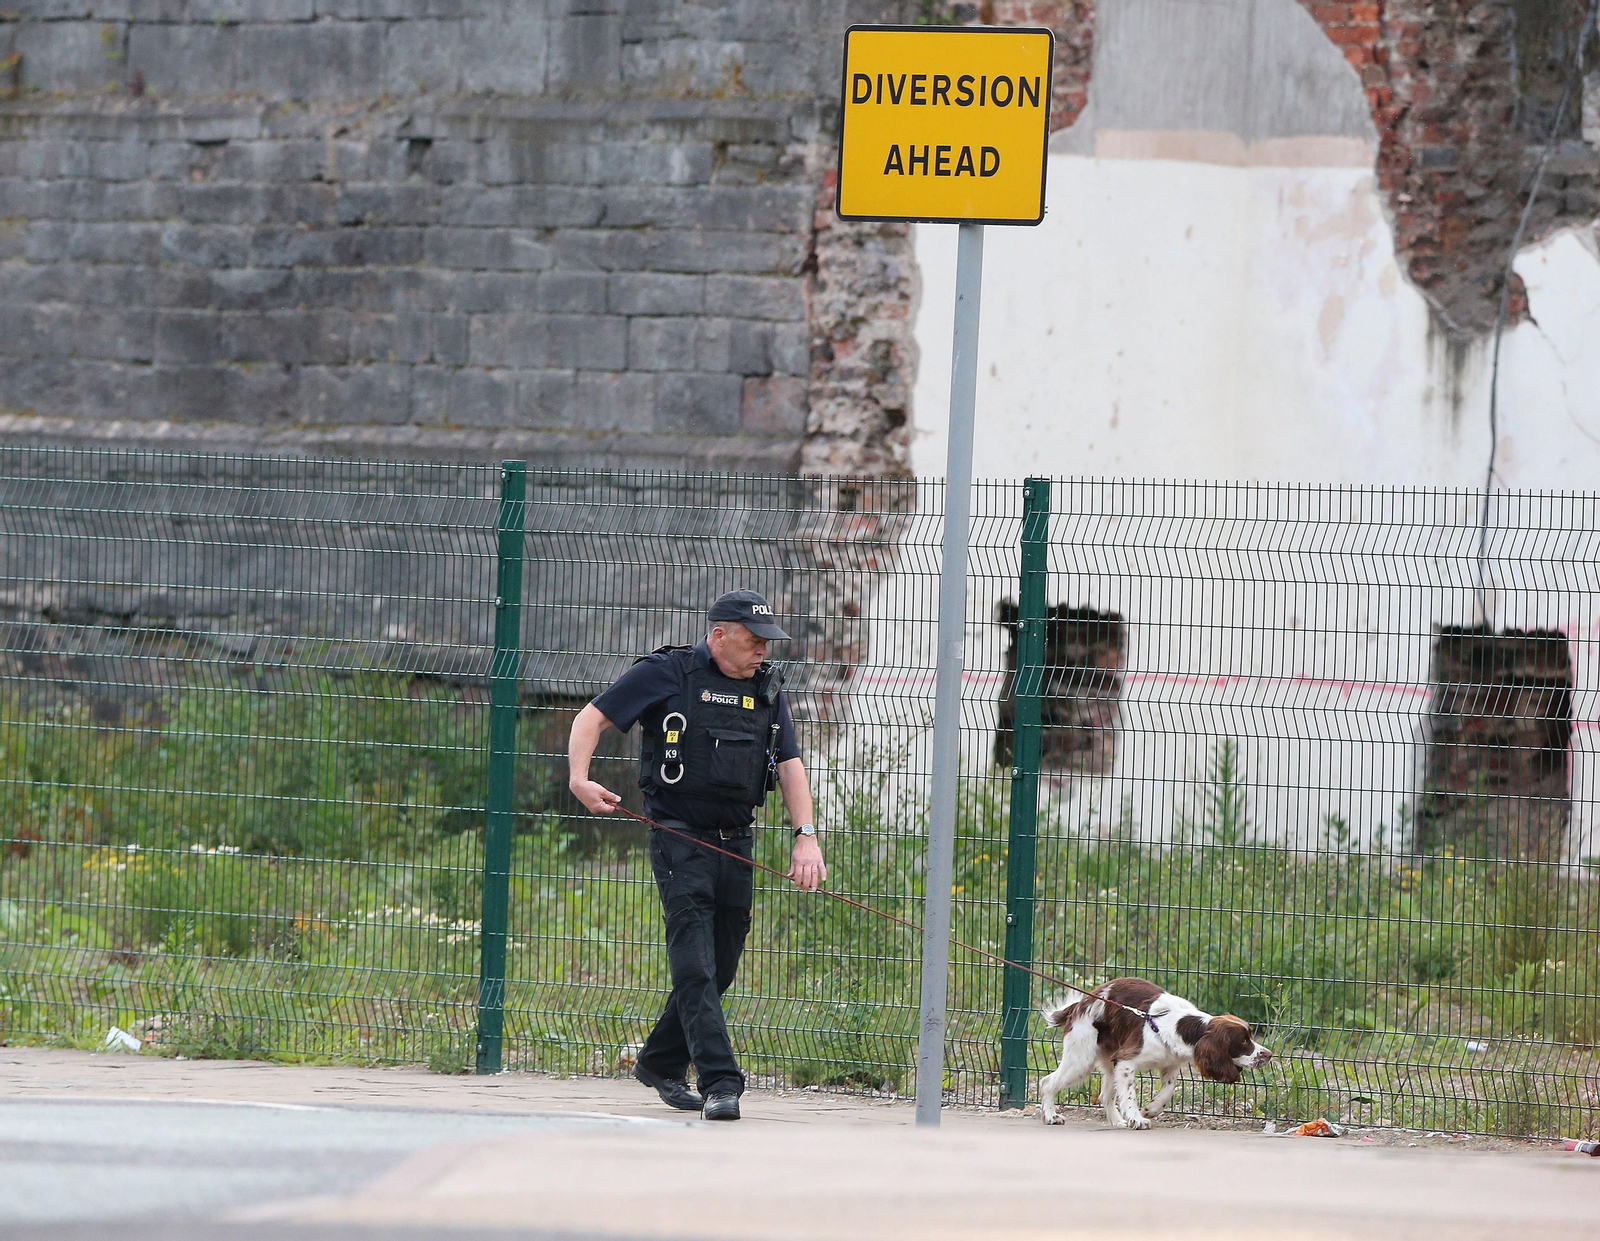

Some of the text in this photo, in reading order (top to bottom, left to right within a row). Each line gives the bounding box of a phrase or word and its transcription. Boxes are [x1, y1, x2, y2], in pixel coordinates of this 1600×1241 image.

[851, 73, 1041, 108] DIVERSION
[883, 144, 1001, 178] AHEAD
[711, 695, 739, 705] POLICE
[665, 749, 677, 759] K9
